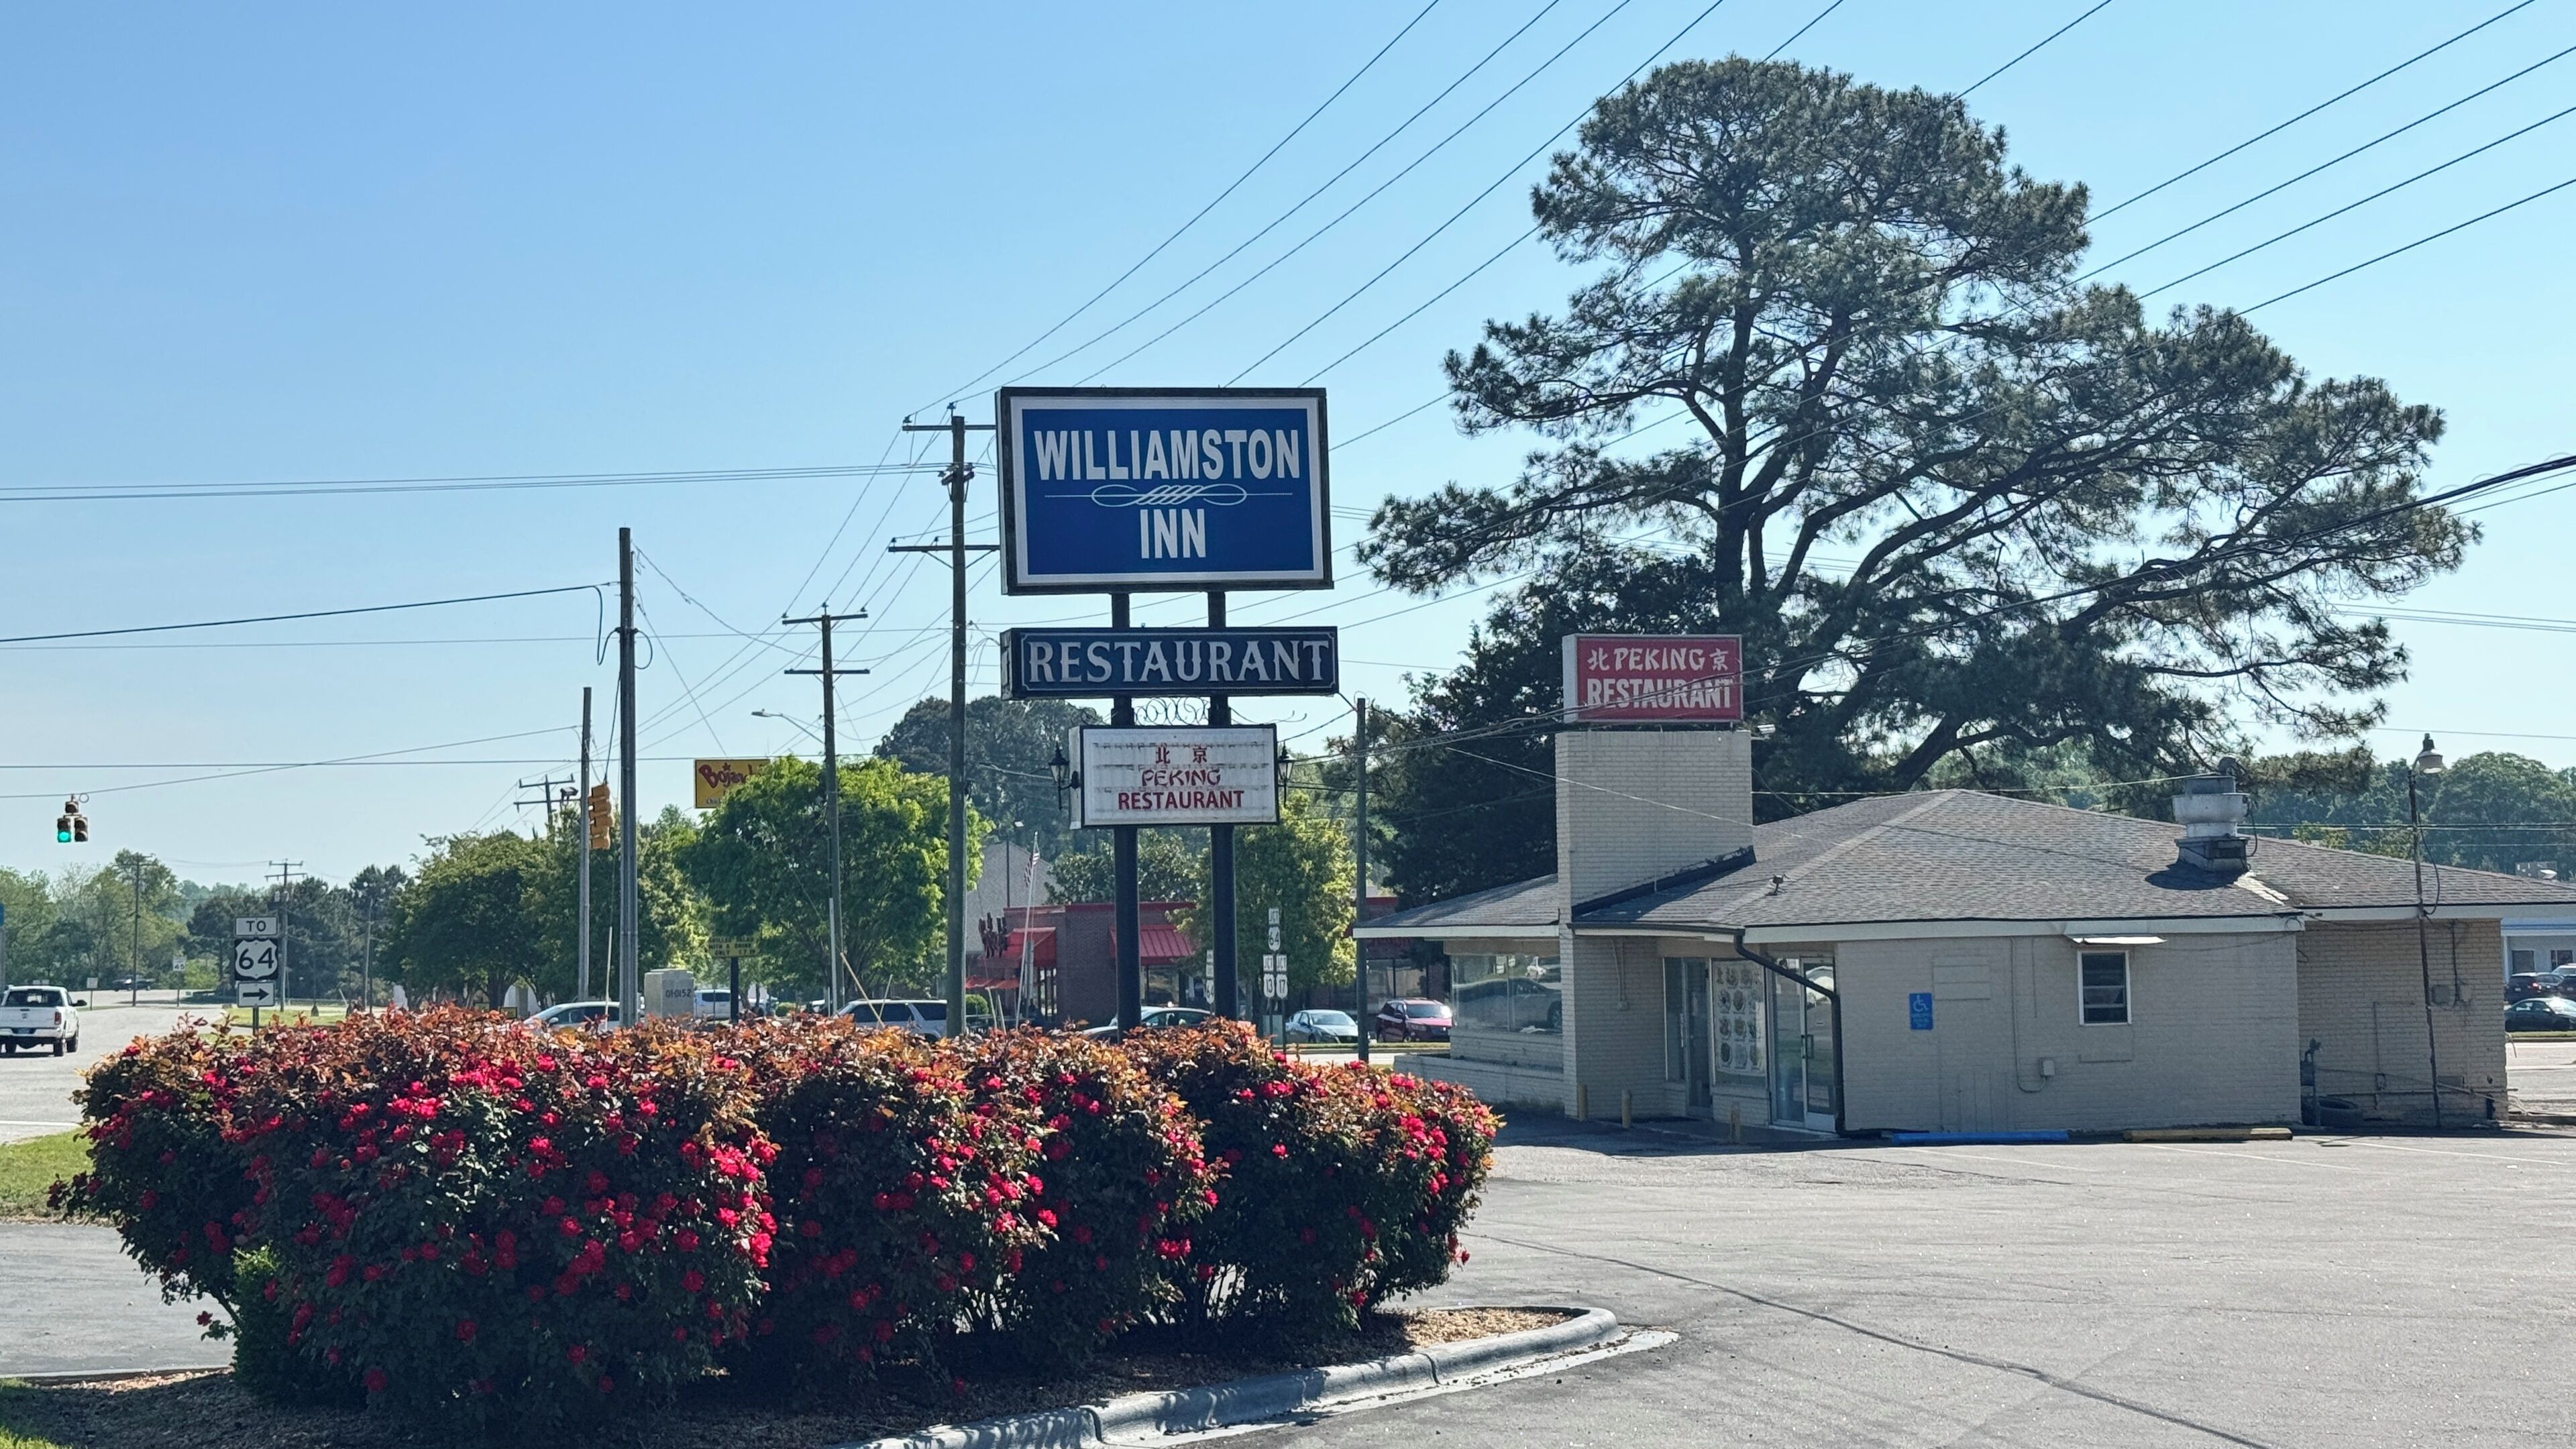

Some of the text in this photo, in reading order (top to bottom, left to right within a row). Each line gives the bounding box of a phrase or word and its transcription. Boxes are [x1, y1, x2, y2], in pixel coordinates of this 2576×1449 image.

[1034, 429, 1300, 480] WILLIAMSTON
[1140, 508, 1206, 559] INN
[1028, 640, 1331, 683] RESTAURANT
[1587, 647, 1729, 671] 北 PEKING 京
[1587, 678, 1735, 708] RESTAURANT
[1142, 769, 1221, 786] PEKING
[1118, 790, 1245, 810] RESTAURANT
[1270, 910, 1279, 923] JCT
[246, 920, 266, 932] TO
[1269, 932, 1279, 946] 64
[239, 947, 274, 970] 64
[1264, 957, 1273, 969] JCT
[1277, 957, 1287, 969] JCT
[1266, 979, 1273, 993] 13
[1279, 979, 1286, 994] 17
